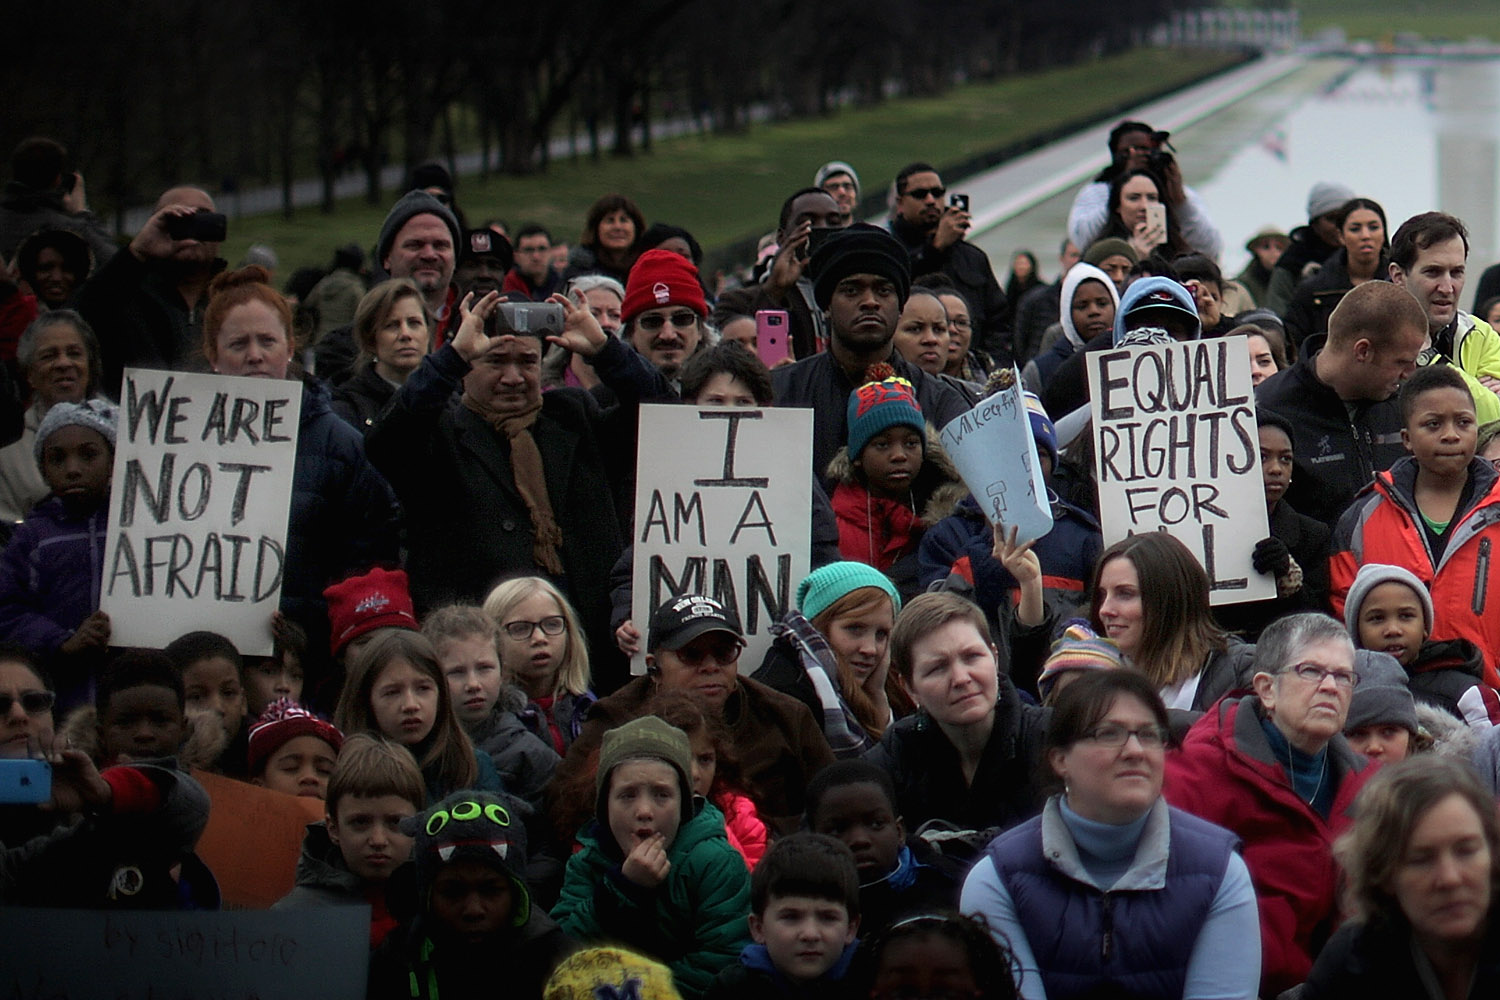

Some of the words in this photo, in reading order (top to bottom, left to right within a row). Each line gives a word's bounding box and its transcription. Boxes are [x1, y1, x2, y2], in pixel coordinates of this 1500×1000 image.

[127, 376, 191, 445] WE
[202, 392, 291, 445] ARE
[1098, 341, 1249, 420] EQUAL
[694, 410, 769, 488] I
[1100, 407, 1256, 482] RIGHTS
[119, 452, 272, 527] NOT
[641, 489, 707, 546] AM
[729, 490, 777, 546] A
[1125, 483, 1230, 525] FOR
[107, 532, 284, 603] AFRAID
[649, 554, 791, 636] MAN
